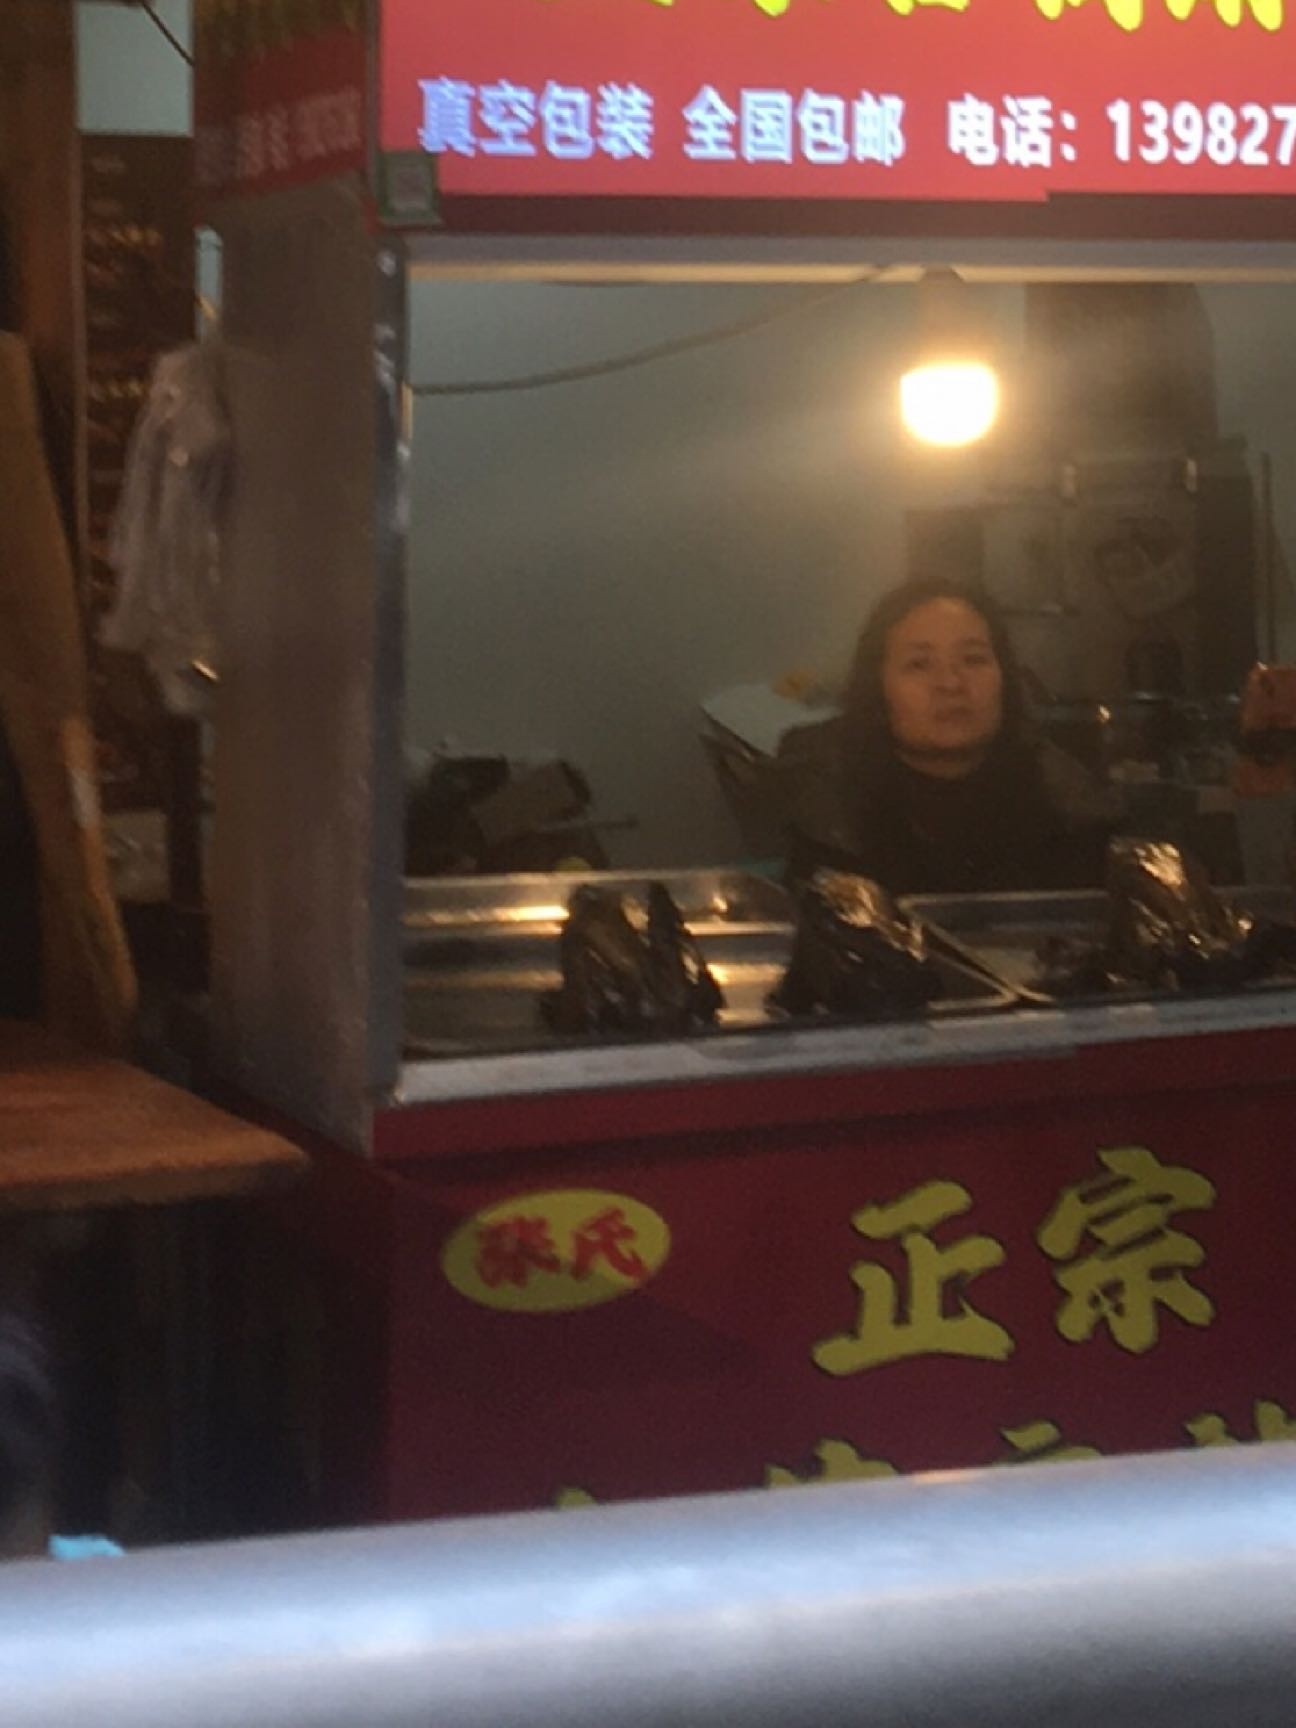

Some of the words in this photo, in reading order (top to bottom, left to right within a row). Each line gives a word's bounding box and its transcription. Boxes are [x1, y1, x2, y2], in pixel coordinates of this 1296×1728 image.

[418, 76, 656, 160] 真空包装
[682, 84, 908, 168] 全国包邮
[474, 1207, 650, 1293] 张氏
[813, 1146, 1218, 1378] 正宗
